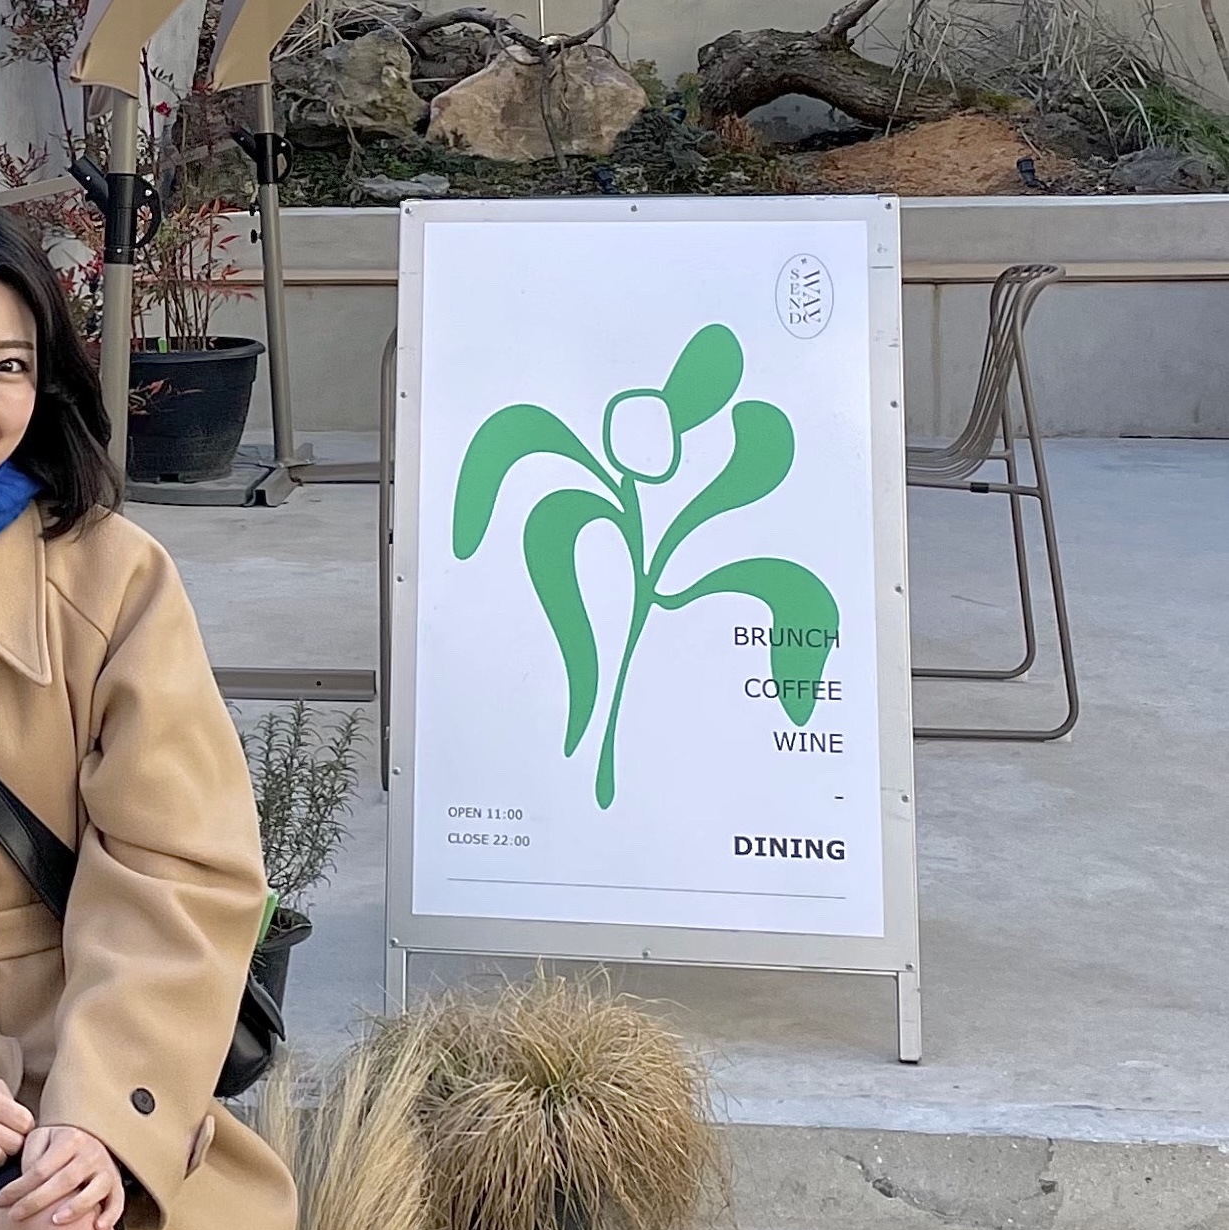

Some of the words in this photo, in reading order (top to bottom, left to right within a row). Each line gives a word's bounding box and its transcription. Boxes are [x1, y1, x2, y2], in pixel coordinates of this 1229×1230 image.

[733, 626, 840, 649] BRUNCH
[744, 678, 842, 700] COFFEE
[773, 731, 844, 753] WINE
[448, 806, 482, 818] OPEN
[487, 808, 523, 820] 11:00
[447, 832, 489, 845] CLOSE
[493, 834, 530, 847] 22:00
[734, 836, 845, 861] DINING
